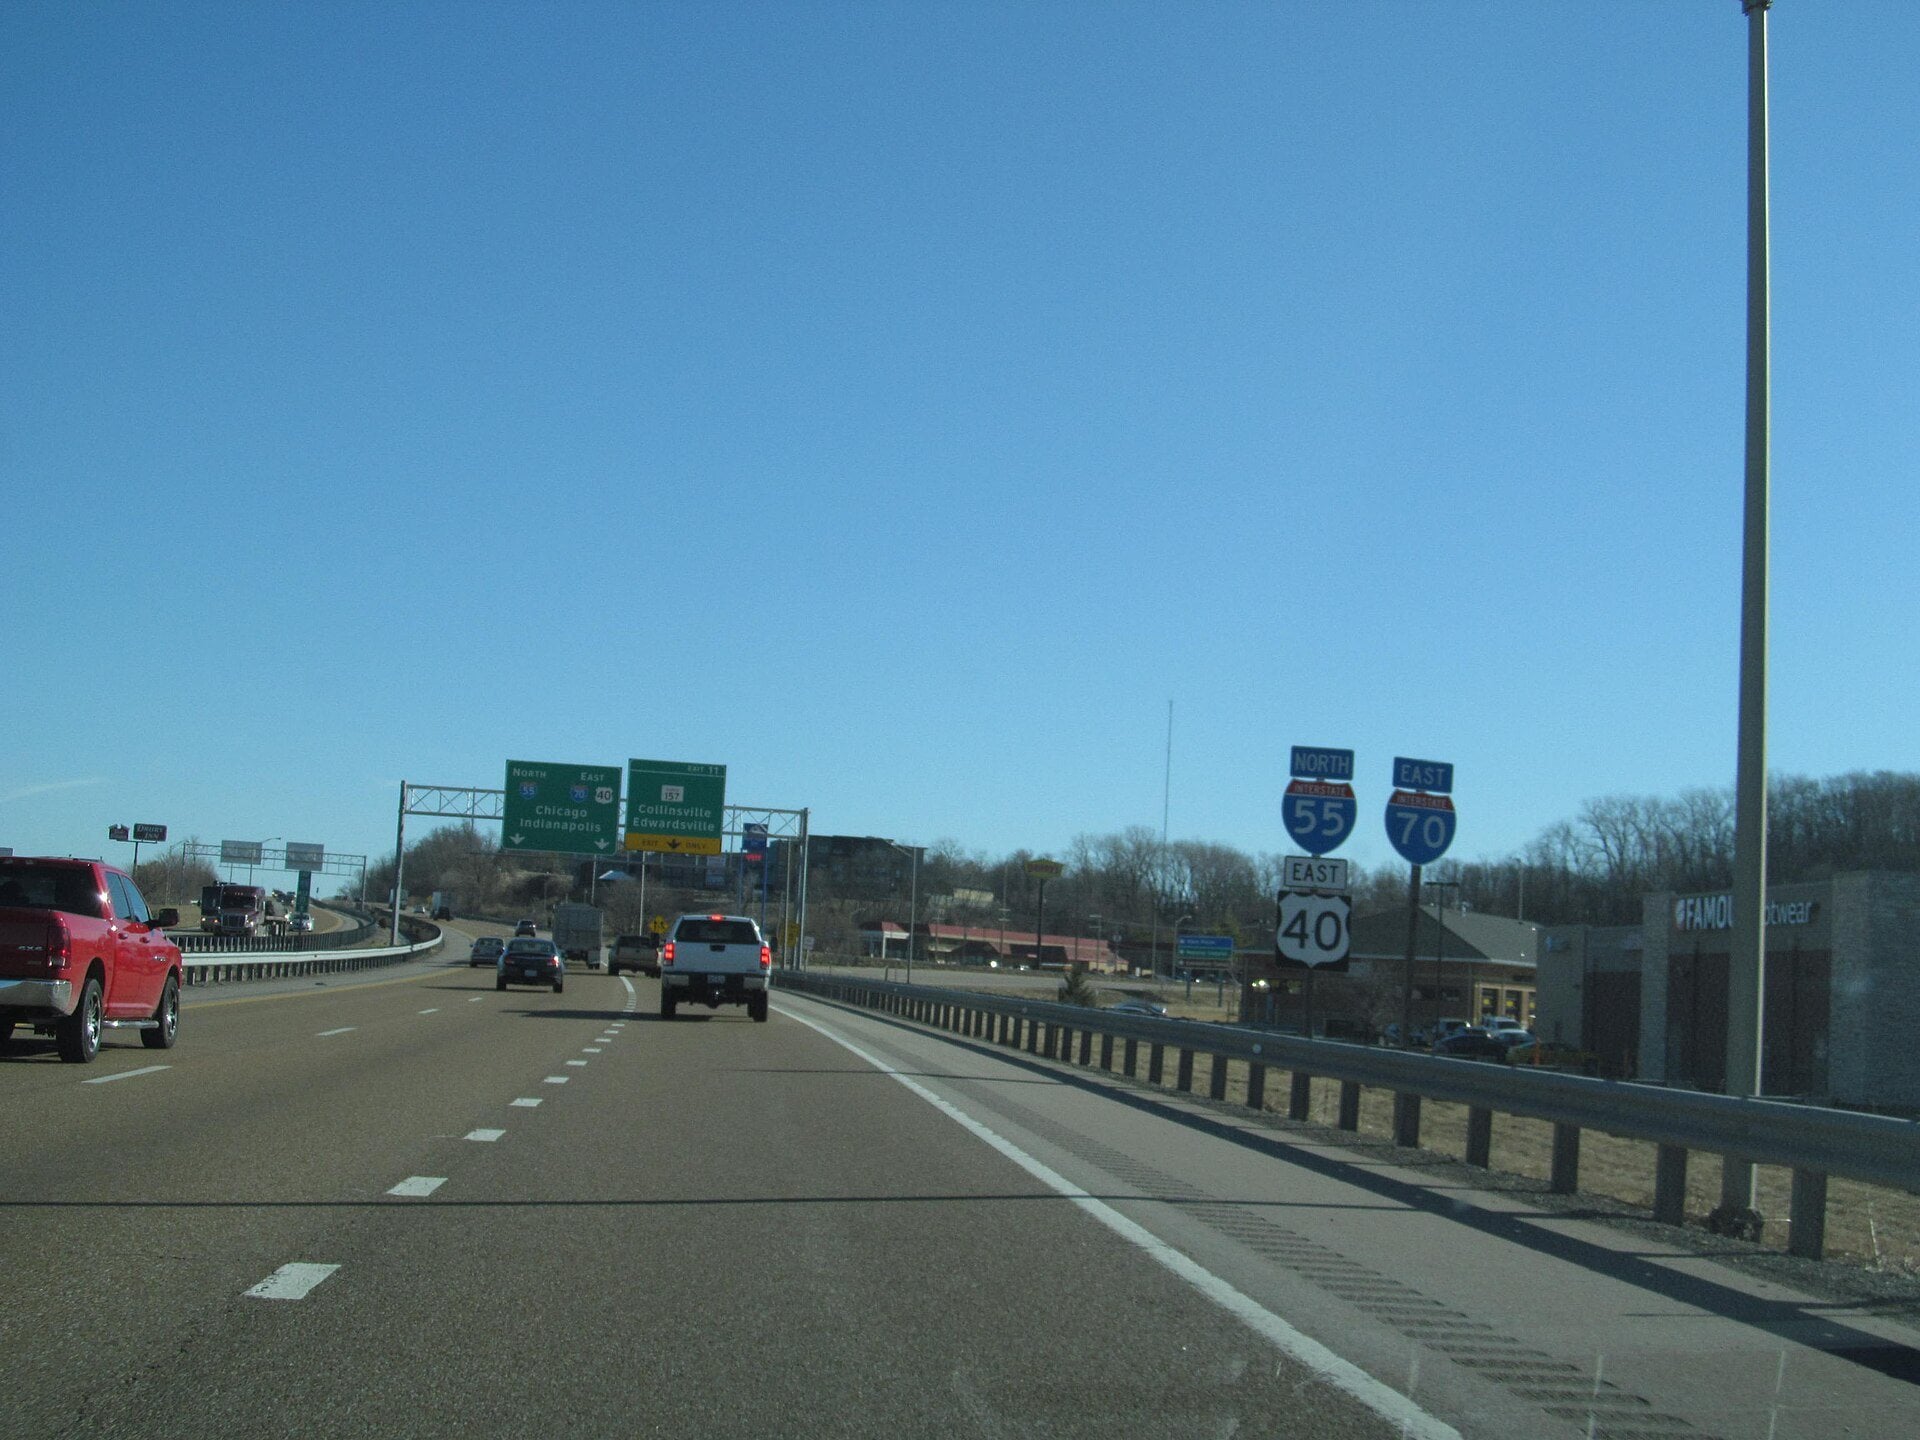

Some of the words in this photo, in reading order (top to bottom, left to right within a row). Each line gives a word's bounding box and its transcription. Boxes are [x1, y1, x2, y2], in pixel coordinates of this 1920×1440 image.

[1295, 753, 1349, 774] NORTH
[512, 768, 546, 778] NORTH
[581, 772, 604, 781] EAST
[1401, 765, 1445, 786] EAST
[522, 786, 535, 795] 55
[597, 790, 611, 800] 40
[664, 792, 680, 800] 157
[1294, 784, 1346, 797] INTERSTATE
[1396, 795, 1447, 809] INTERSTATE
[535, 805, 588, 819] Chicago
[638, 804, 712, 817] Collinsville
[632, 817, 715, 832] Edwardsville
[1294, 800, 1344, 836] 55
[519, 818, 602, 833] Indianapolis
[1396, 812, 1445, 849] 70
[1293, 863, 1338, 882] EAST
[1282, 910, 1342, 951] 40
